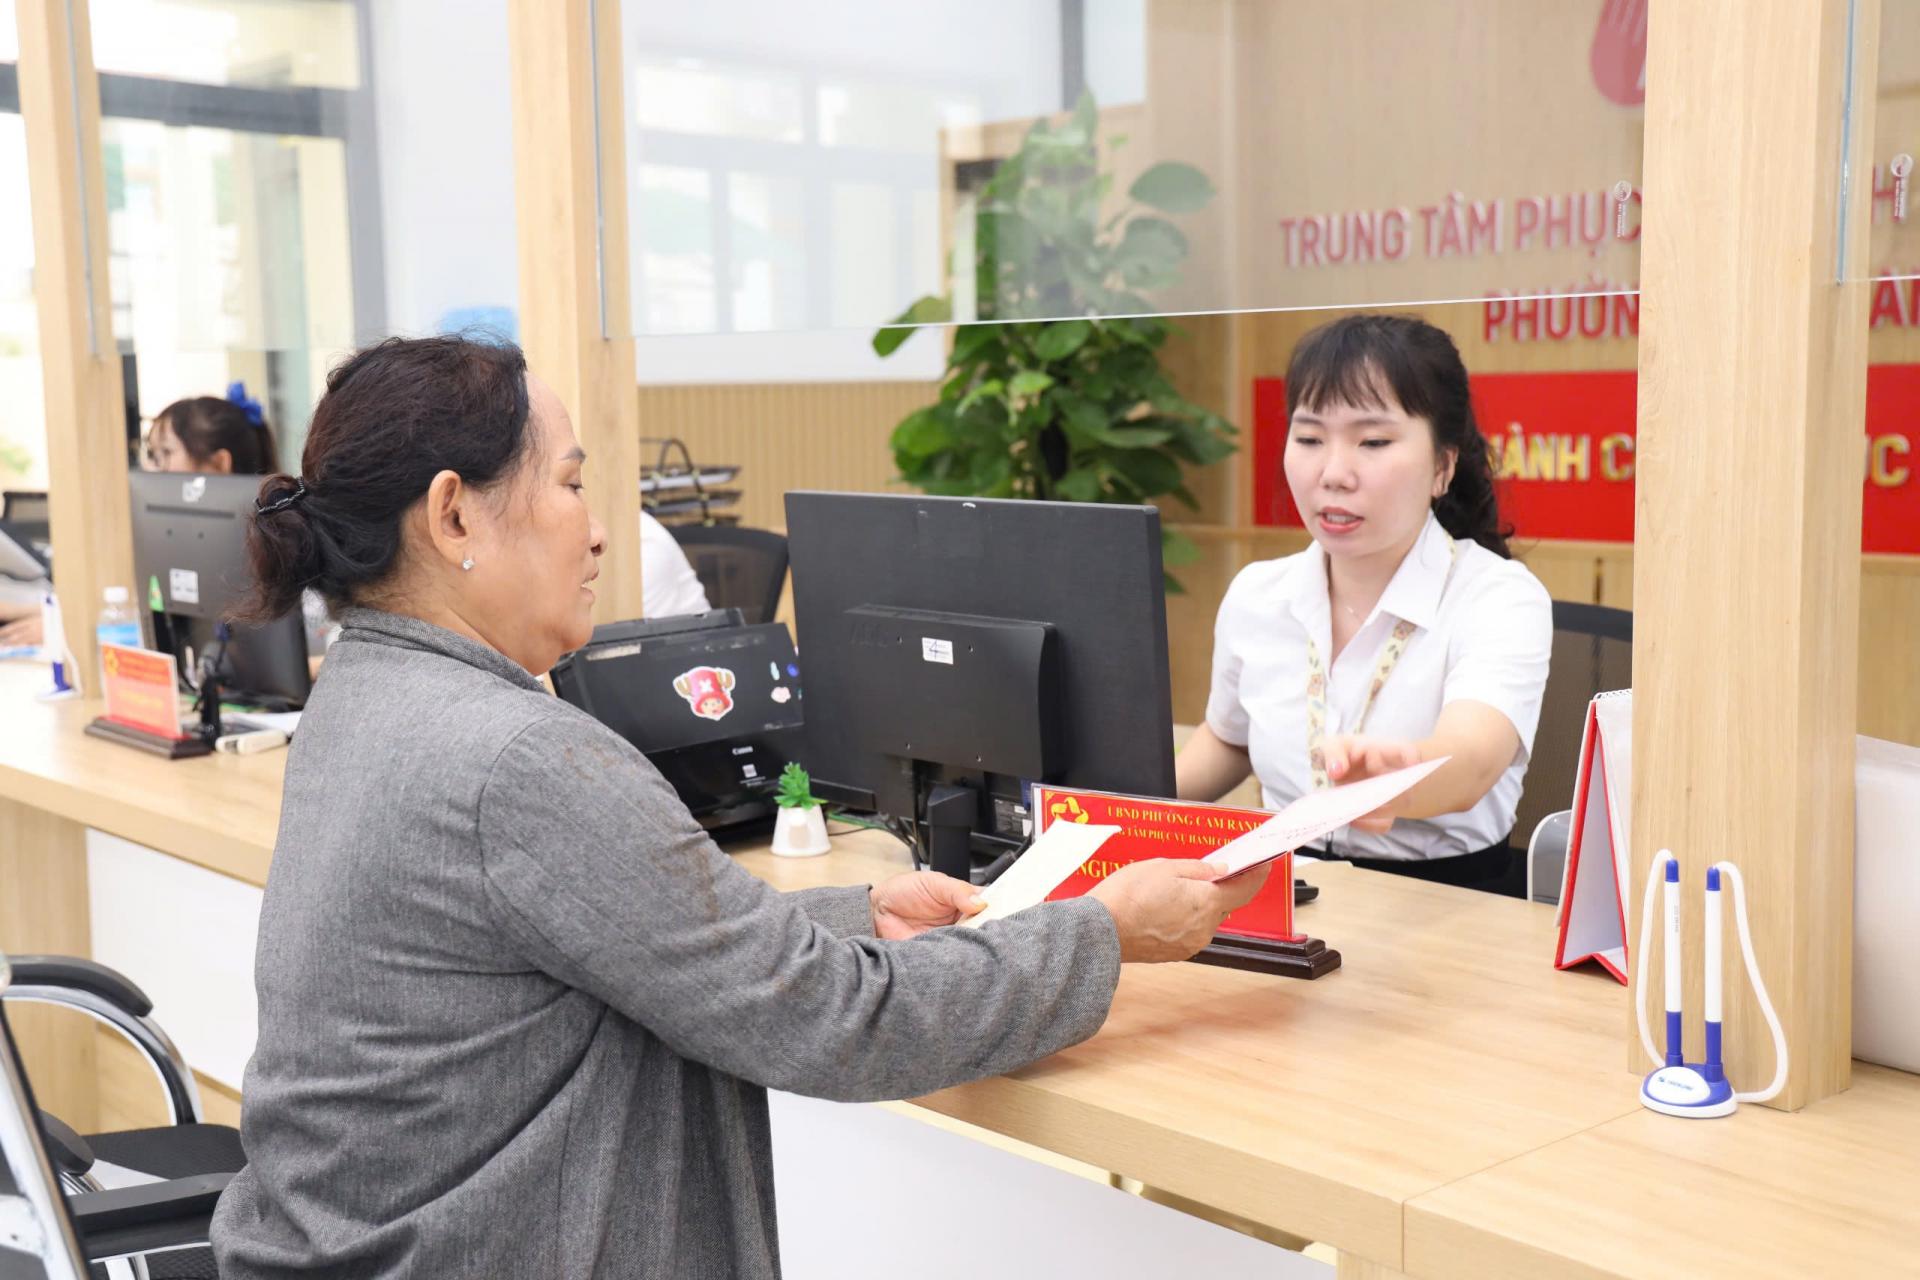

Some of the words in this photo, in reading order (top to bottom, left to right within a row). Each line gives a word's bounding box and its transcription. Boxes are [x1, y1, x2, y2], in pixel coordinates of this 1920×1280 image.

[1280, 207, 1408, 266] TRUNG
[1418, 191, 1502, 258] TÂM
[1513, 187, 1642, 259] PHỤC
[1483, 272, 1640, 342] PHƯỜN
[1195, 814, 1225, 830] CAM
